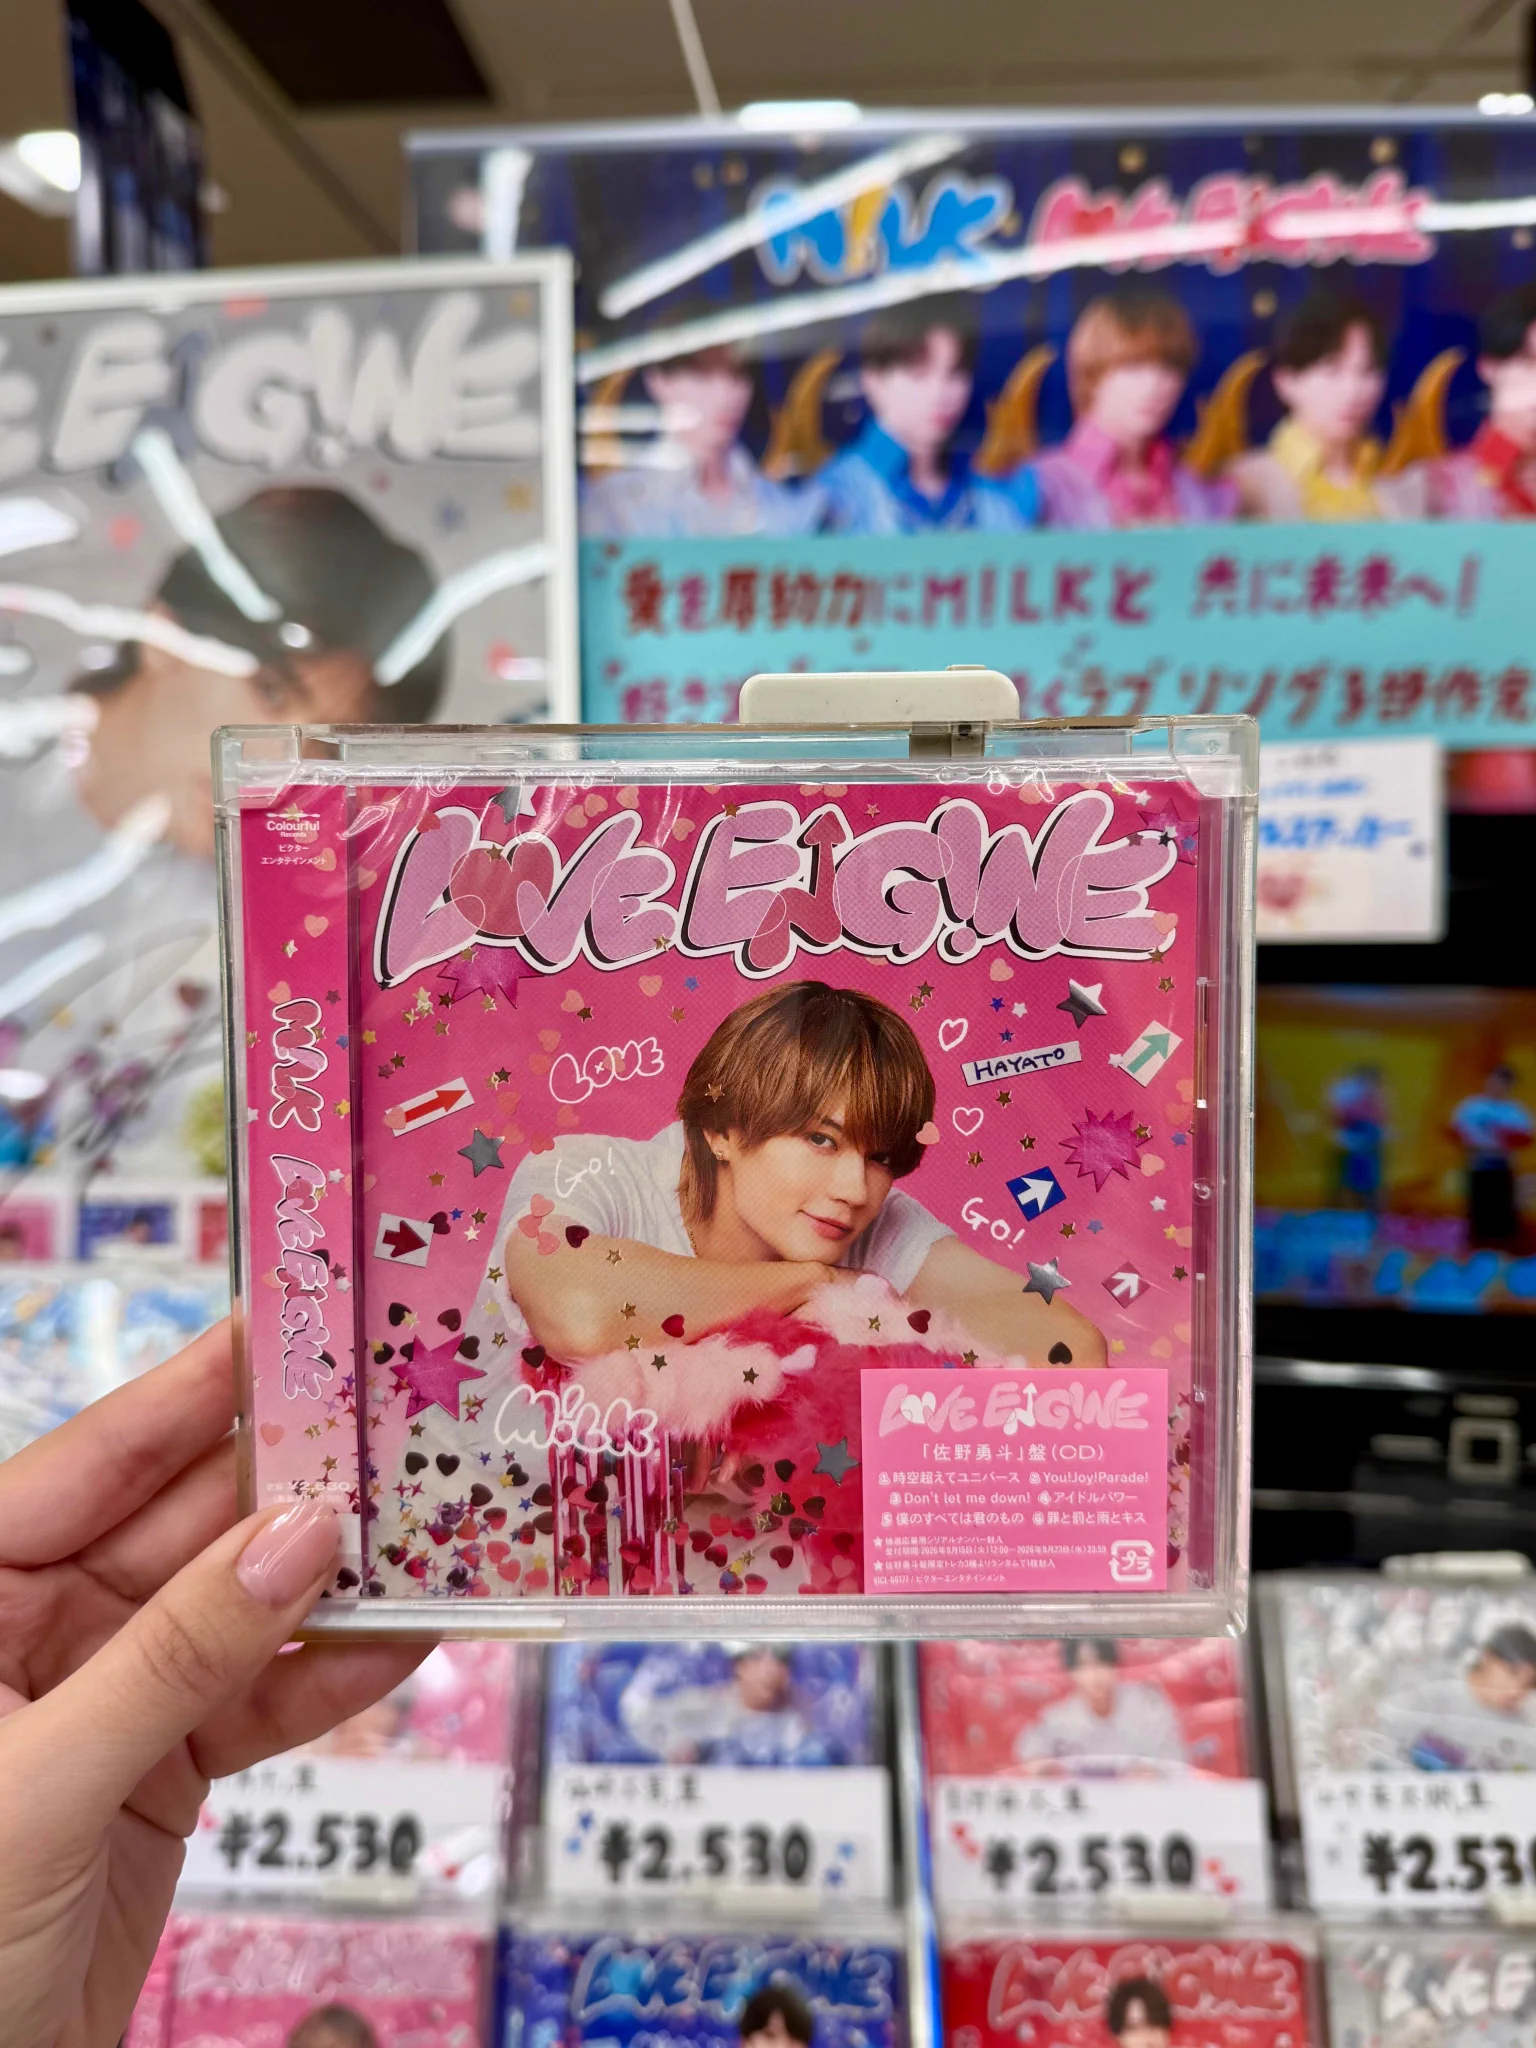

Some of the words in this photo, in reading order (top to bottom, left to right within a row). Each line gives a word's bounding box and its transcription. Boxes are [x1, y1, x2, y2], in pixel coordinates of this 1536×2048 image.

[266, 820, 320, 831] Colourful
[279, 844, 310, 853] ビクター
[261, 857, 327, 866] エンタテインメント
[549, 1037, 665, 1104] LOVE
[974, 1048, 1065, 1080] HAYATO
[943, 1492, 961, 1505] let
[965, 1493, 987, 1505] me
[990, 1491, 1031, 1505] down!
[1121, 1549, 1150, 1571] プラ
